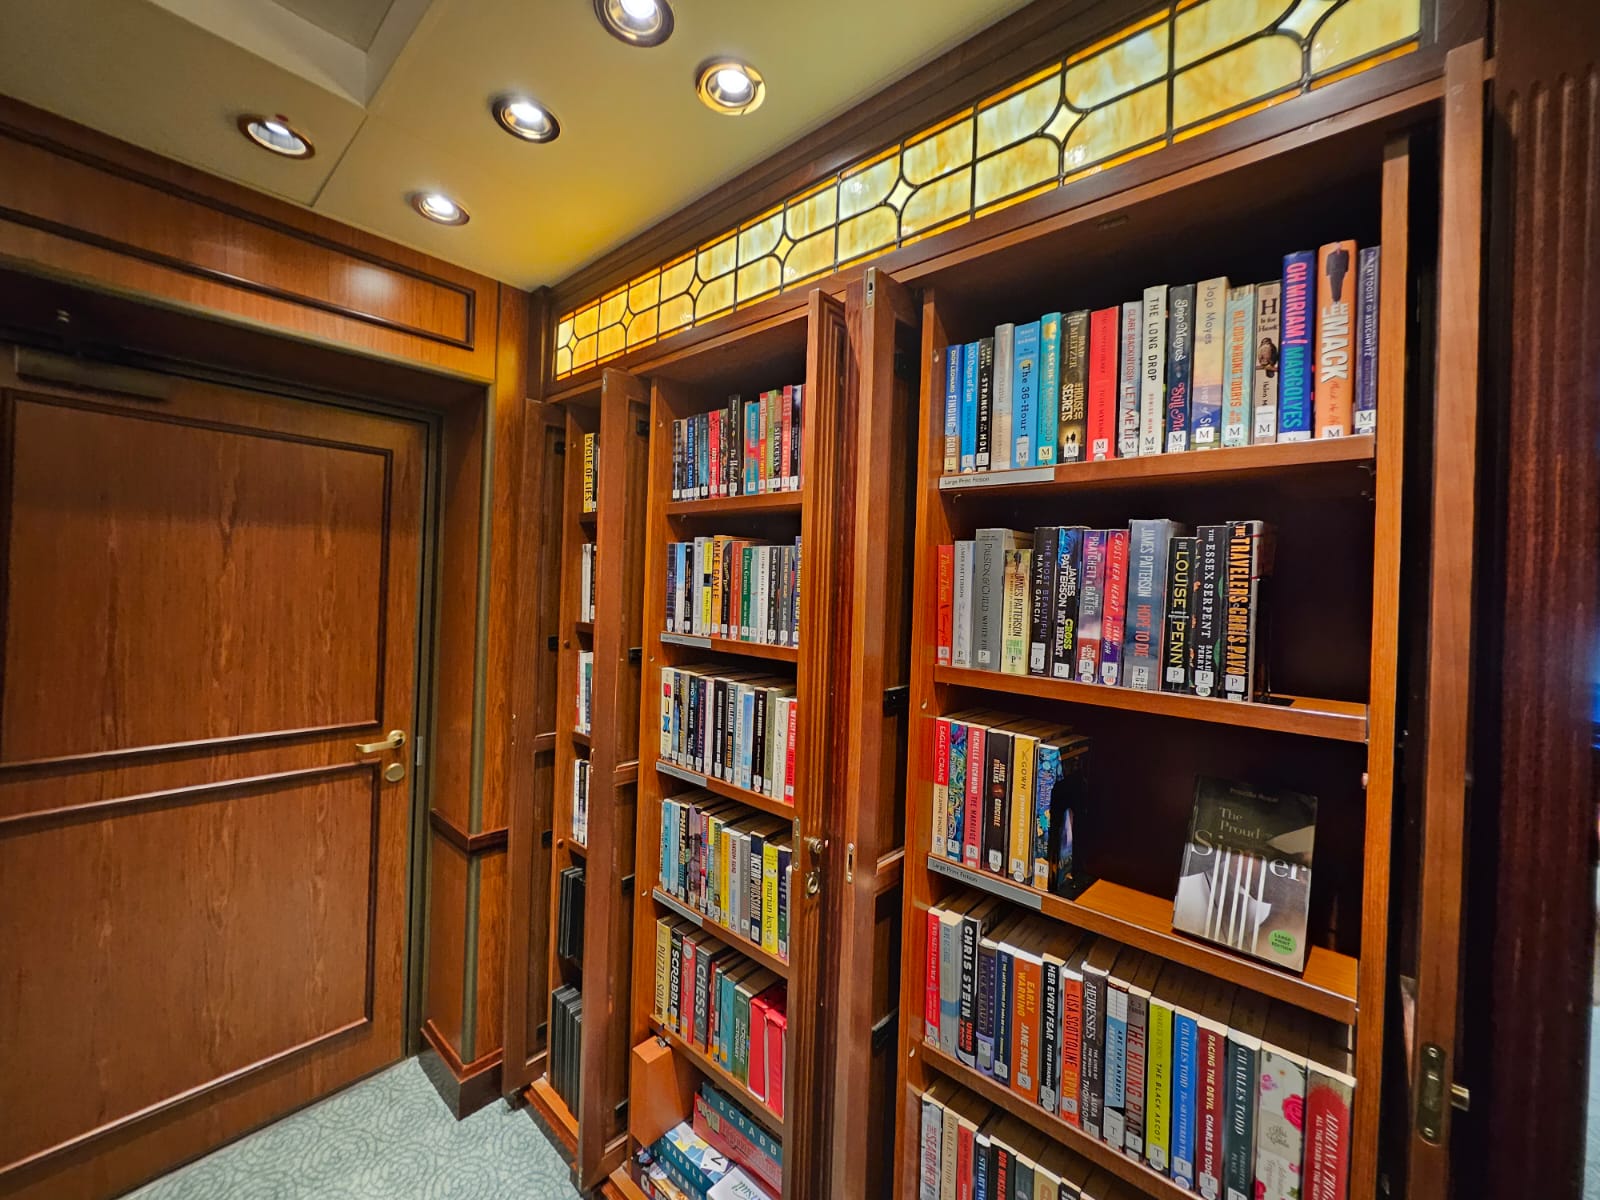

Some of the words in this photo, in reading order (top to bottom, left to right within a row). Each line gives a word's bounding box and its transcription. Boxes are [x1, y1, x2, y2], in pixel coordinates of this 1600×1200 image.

[1286, 262, 1307, 281] OH
[1366, 263, 1375, 303] TATTOOIST
[1149, 298, 1159, 318] THE
[1174, 299, 1188, 321] Jojo
[1205, 286, 1217, 309] Jojo
[1260, 298, 1277, 316] H
[1322, 302, 1350, 316] LEE
[1128, 309, 1136, 332] CLARE
[1282, 282, 1308, 345] MIRIAM!
[1148, 321, 1158, 349] LONG
[1173, 322, 1188, 362] Moyes
[1204, 312, 1217, 345] Moyes
[1233, 326, 1245, 341] OUR
[1258, 324, 1278, 333] Hawk
[1364, 315, 1373, 357] AUSCHWITZ
[1069, 327, 1078, 368] MELTZER
[1125, 334, 1136, 381] MACKINTOSH
[1232, 343, 1245, 374] WRONG
[1320, 318, 1350, 383] MACK
[1021, 364, 1031, 383] The
[1047, 353, 1056, 386] SECRET
[1147, 354, 1158, 381] DROP
[966, 388, 974, 402] Sun
[1074, 388, 1084, 411] HOUSE
[1125, 386, 1135, 405] LET
[1169, 382, 1185, 410] Still
[1231, 376, 1243, 407] TODAYS
[1283, 346, 1304, 429] MARGOLYES
[948, 395, 957, 427] FINDING
[1020, 386, 1030, 430] 36-Hour
[1061, 384, 1074, 422] SECRETS
[1124, 407, 1135, 426] ME
[584, 436, 594, 465] CYCLE
[946, 437, 954, 456] GOBI
[584, 482, 592, 502] LIES
[1140, 528, 1155, 554] JAMES
[1235, 525, 1245, 536] THE
[713, 540, 721, 568] MIKE
[982, 543, 993, 576] PRESTON
[1086, 536, 1099, 578] PRATCHETT
[1113, 532, 1124, 559] CROSS
[1035, 554, 1044, 584] MAYTE
[1043, 561, 1051, 585] MOST
[1111, 563, 1121, 581] HER
[1137, 555, 1154, 598] PATTERSON
[1204, 544, 1216, 580] ESSEX
[1228, 538, 1250, 604] TRAVELERS
[712, 569, 720, 600] GAYLE
[1014, 573, 1025, 597] JAMES
[1058, 554, 1069, 607] PATTERSON
[1067, 566, 1077, 597] JAMES
[1173, 551, 1189, 608] LOUISE
[981, 586, 992, 614] CHILD
[1034, 589, 1043, 624] GARCIA
[1084, 586, 1096, 615] BAXTER
[1110, 584, 1121, 612] HEART
[1200, 583, 1214, 639] SERPENT
[1012, 599, 1024, 637] PATTERSON
[1040, 590, 1050, 639] BEAUTIFUL
[1057, 610, 1066, 625] MY
[1135, 605, 1151, 628] HOPE
[1227, 607, 1248, 642] CHRIS
[1055, 626, 1065, 657] HEART
[1063, 618, 1074, 650] CROSS
[1135, 630, 1150, 642] TO
[1134, 644, 1149, 656] DIE
[1197, 645, 1205, 670] PERRY
[1225, 646, 1246, 675] PAVO
[938, 725, 946, 750] EAGLE
[971, 731, 980, 760] MICHELLE
[937, 757, 945, 782] CRANE
[970, 763, 979, 794] RICHMOND
[998, 763, 1006, 783] JAMES
[1020, 762, 1028, 790] GOWN
[970, 796, 978, 807] THE
[1219, 807, 1243, 820] The
[968, 810, 977, 841] MARRIAGE
[1220, 820, 1261, 839] Proud
[933, 863, 946, 871] Large
[962, 925, 973, 970] CHRIS
[657, 944, 666, 981] PUZZLE
[1047, 965, 1056, 986] HER
[695, 963, 706, 1017] CHESS
[962, 972, 972, 1018] STEIN
[1017, 972, 1026, 1017] WARNING
[1026, 981, 1035, 1012] EARLY
[1046, 988, 1056, 1015] EVERY
[1066, 993, 1079, 1013] LISA
[979, 993, 988, 1034] BEAUTY
[1084, 981, 1098, 1040] HEIRESSES
[965, 1022, 973, 1051] UNDER
[1020, 1022, 1029, 1048] JANE
[1045, 1016, 1055, 1040] FEAR
[1065, 1015, 1079, 1066] SCOTTOLINE
[1127, 1023, 1144, 1044] THE
[1180, 1022, 1189, 1062] CHARLES
[1206, 1034, 1216, 1067] RACING
[1063, 1070, 1077, 1098] EXPOS
[1126, 1053, 1144, 1096] HIDING
[1180, 1064, 1188, 1088] TODD
[1206, 1069, 1215, 1084] THE
[1235, 1047, 1247, 1101] CHARLES
[1090, 1093, 1098, 1117] LAURA
[1205, 1086, 1215, 1110] DEVIL
[719, 1101, 777, 1155] SCRABB
[1125, 1100, 1142, 1136] PLAC
[1204, 1114, 1214, 1151] CHARLES
[1234, 1104, 1246, 1135] TODD
[1325, 1109, 1339, 1167] ADRIANA
[660, 1138, 703, 1184] CRABBLE
[924, 1133, 937, 1186] SEARCHER
[977, 1156, 986, 1188] STUART
[998, 1150, 1007, 1168] DON
